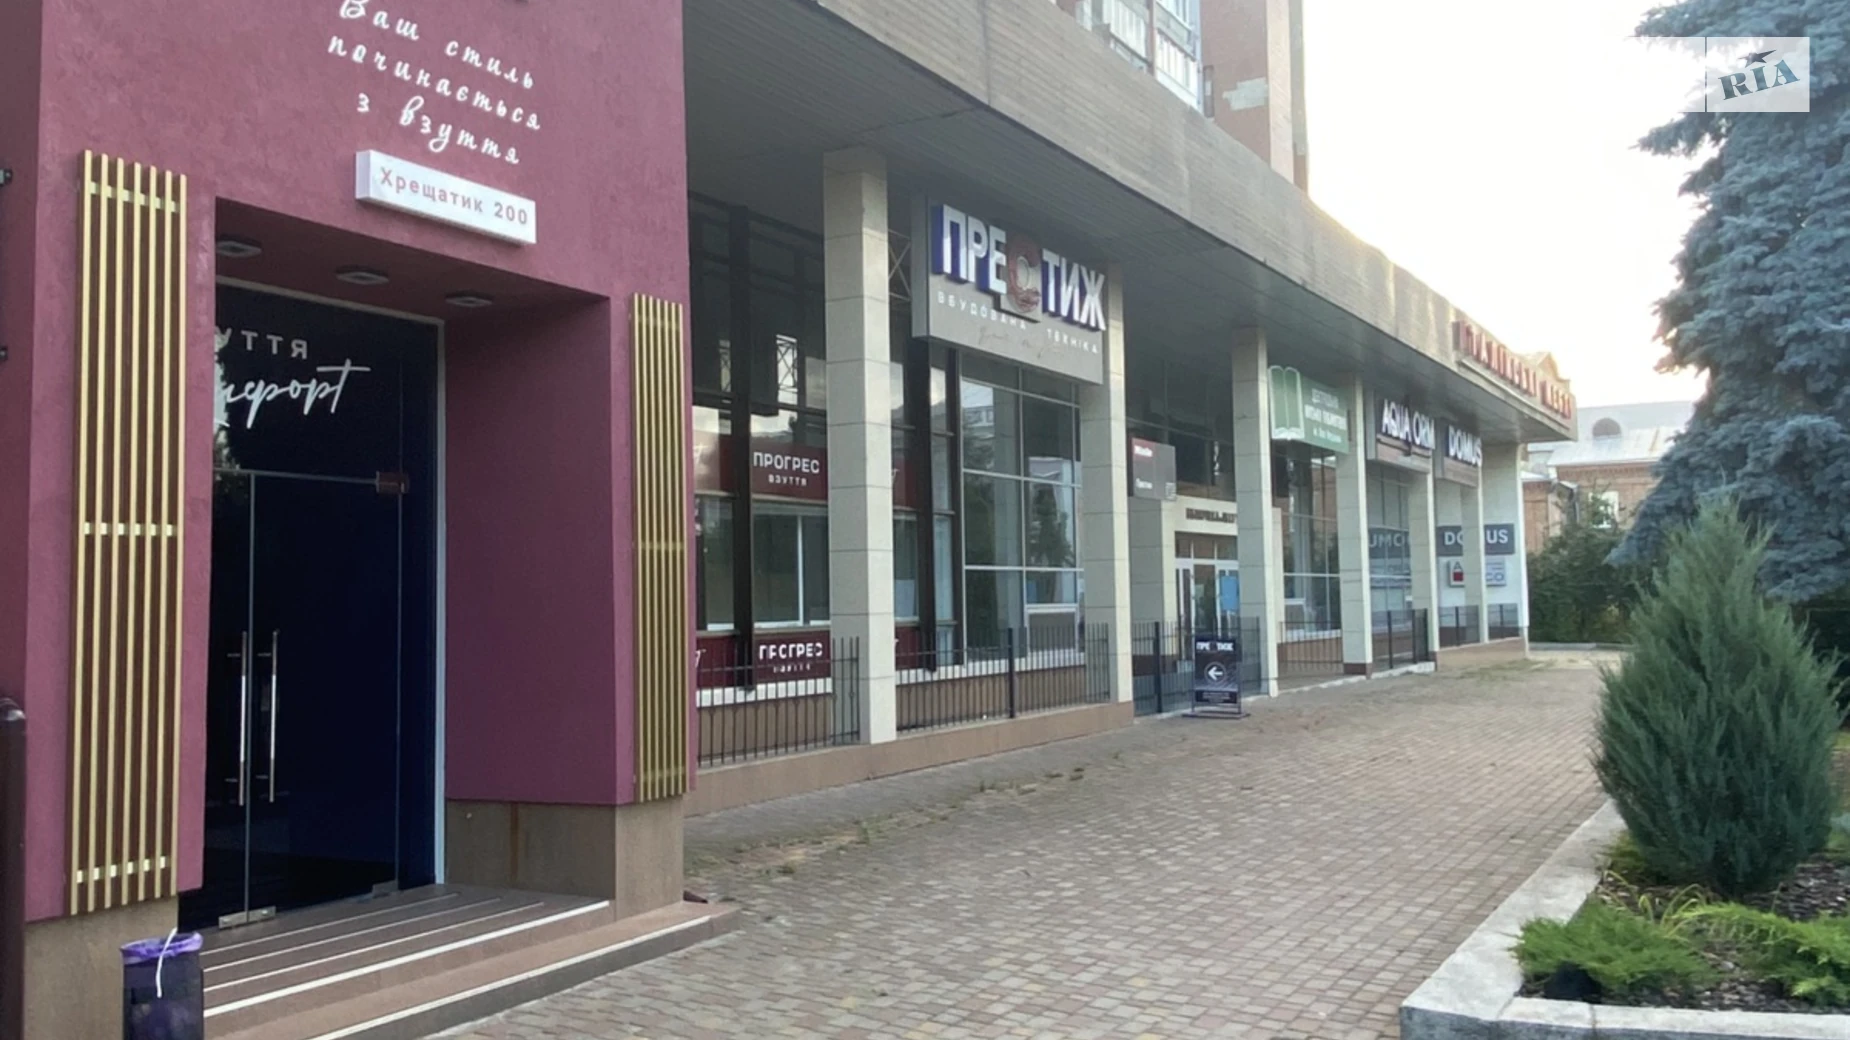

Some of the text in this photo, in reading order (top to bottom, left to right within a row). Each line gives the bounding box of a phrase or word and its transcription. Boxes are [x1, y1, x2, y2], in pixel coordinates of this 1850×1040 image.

[327, 36, 540, 130] починається
[445, 41, 533, 88] стиль
[357, 93, 519, 164] з взуття
[380, 167, 527, 225] Хрещатик 200
[936, 204, 1106, 331] ПРЕСТИЖ
[753, 451, 820, 474] ПРОГРЕС
